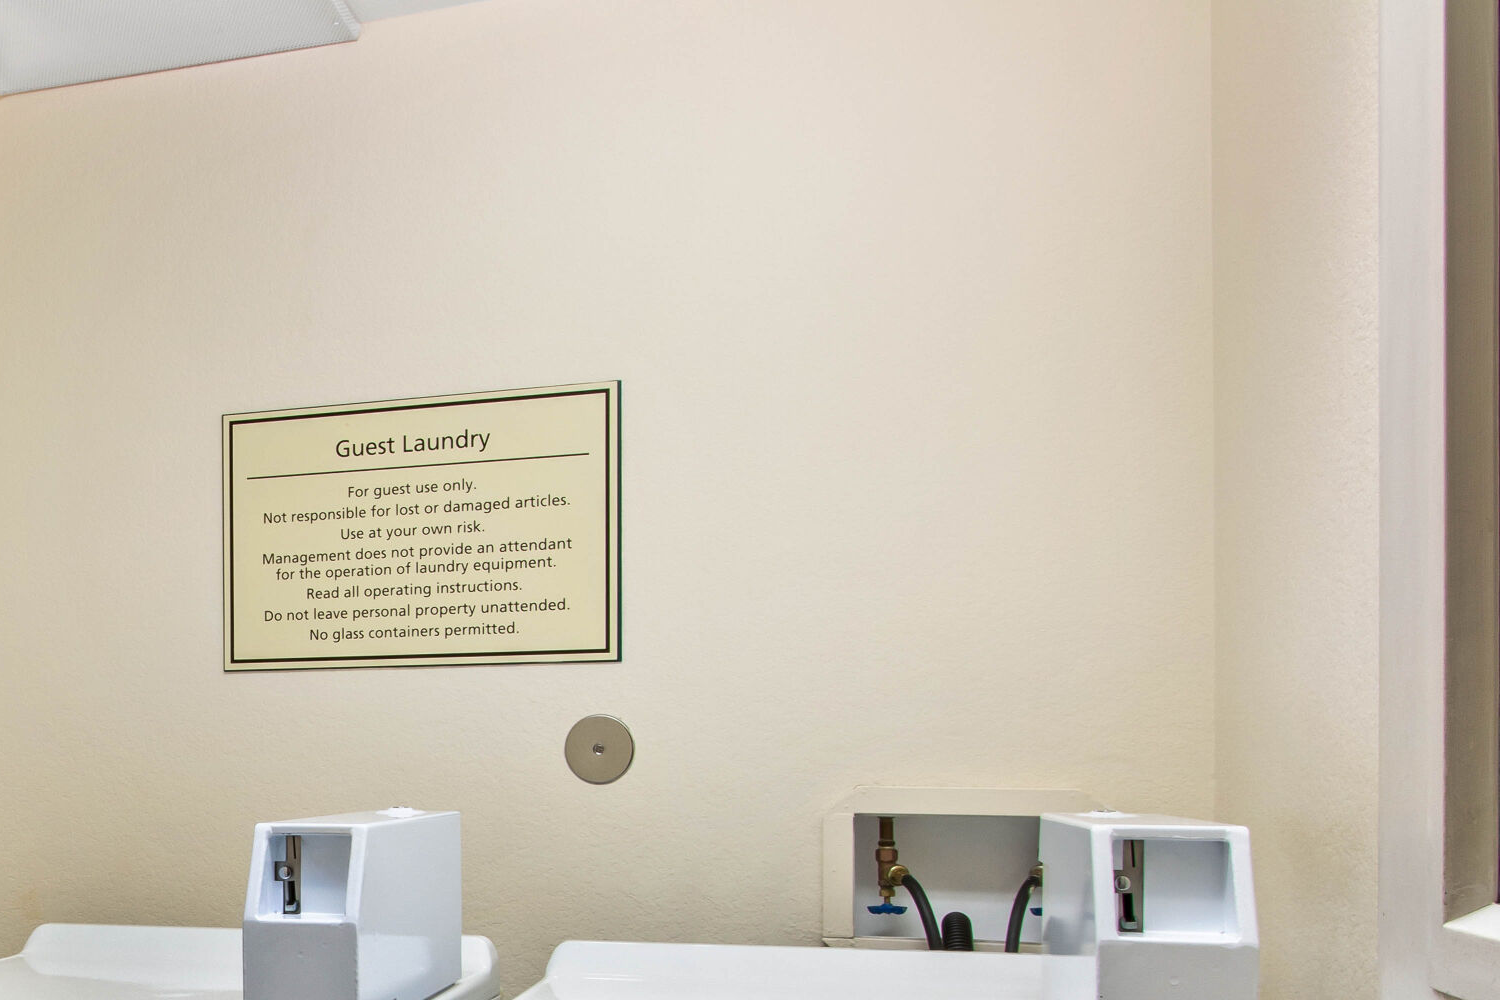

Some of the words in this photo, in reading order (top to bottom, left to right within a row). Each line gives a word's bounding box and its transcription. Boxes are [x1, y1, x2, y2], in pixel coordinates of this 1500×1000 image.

[336, 437, 395, 457] Guest
[403, 428, 490, 452] Laundry
[348, 486, 369, 498] For
[373, 483, 410, 499] guest
[416, 483, 438, 493] use
[443, 478, 476, 493] only.
[263, 512, 287, 524] Not
[291, 506, 366, 524] responsible
[371, 504, 390, 517] for
[395, 503, 419, 515] lost
[424, 504, 438, 514] or
[443, 496, 510, 513] damaged
[515, 493, 570, 508] articles.
[340, 528, 364, 540] Use
[368, 527, 382, 538] at
[386, 527, 417, 541] your
[422, 525, 452, 535] own
[457, 520, 484, 533] risk.
[262, 550, 351, 569] Management
[355, 547, 386, 560] does
[391, 546, 414, 558] not
[419, 542, 472, 559] provide
[477, 544, 494, 553] an
[499, 537, 572, 552] attendant
[276, 568, 295, 580] for
[299, 567, 321, 579] the
[325, 564, 391, 581] operation
[396, 561, 411, 574] of
[415, 559, 468, 575] laundry
[473, 556, 556, 573] equipment.
[306, 586, 339, 599] Read
[344, 585, 359, 598] all
[364, 583, 431, 599] operating
[436, 579, 521, 593] instructions.
[264, 610, 282, 621] Do
[286, 609, 309, 620] not
[313, 607, 348, 620] leave
[352, 603, 410, 621] personal
[415, 603, 476, 619] property
[481, 597, 569, 613] unattended.
[309, 629, 328, 640] No
[332, 627, 364, 643] glass
[368, 625, 439, 638] containers
[444, 621, 519, 639] permitted.
